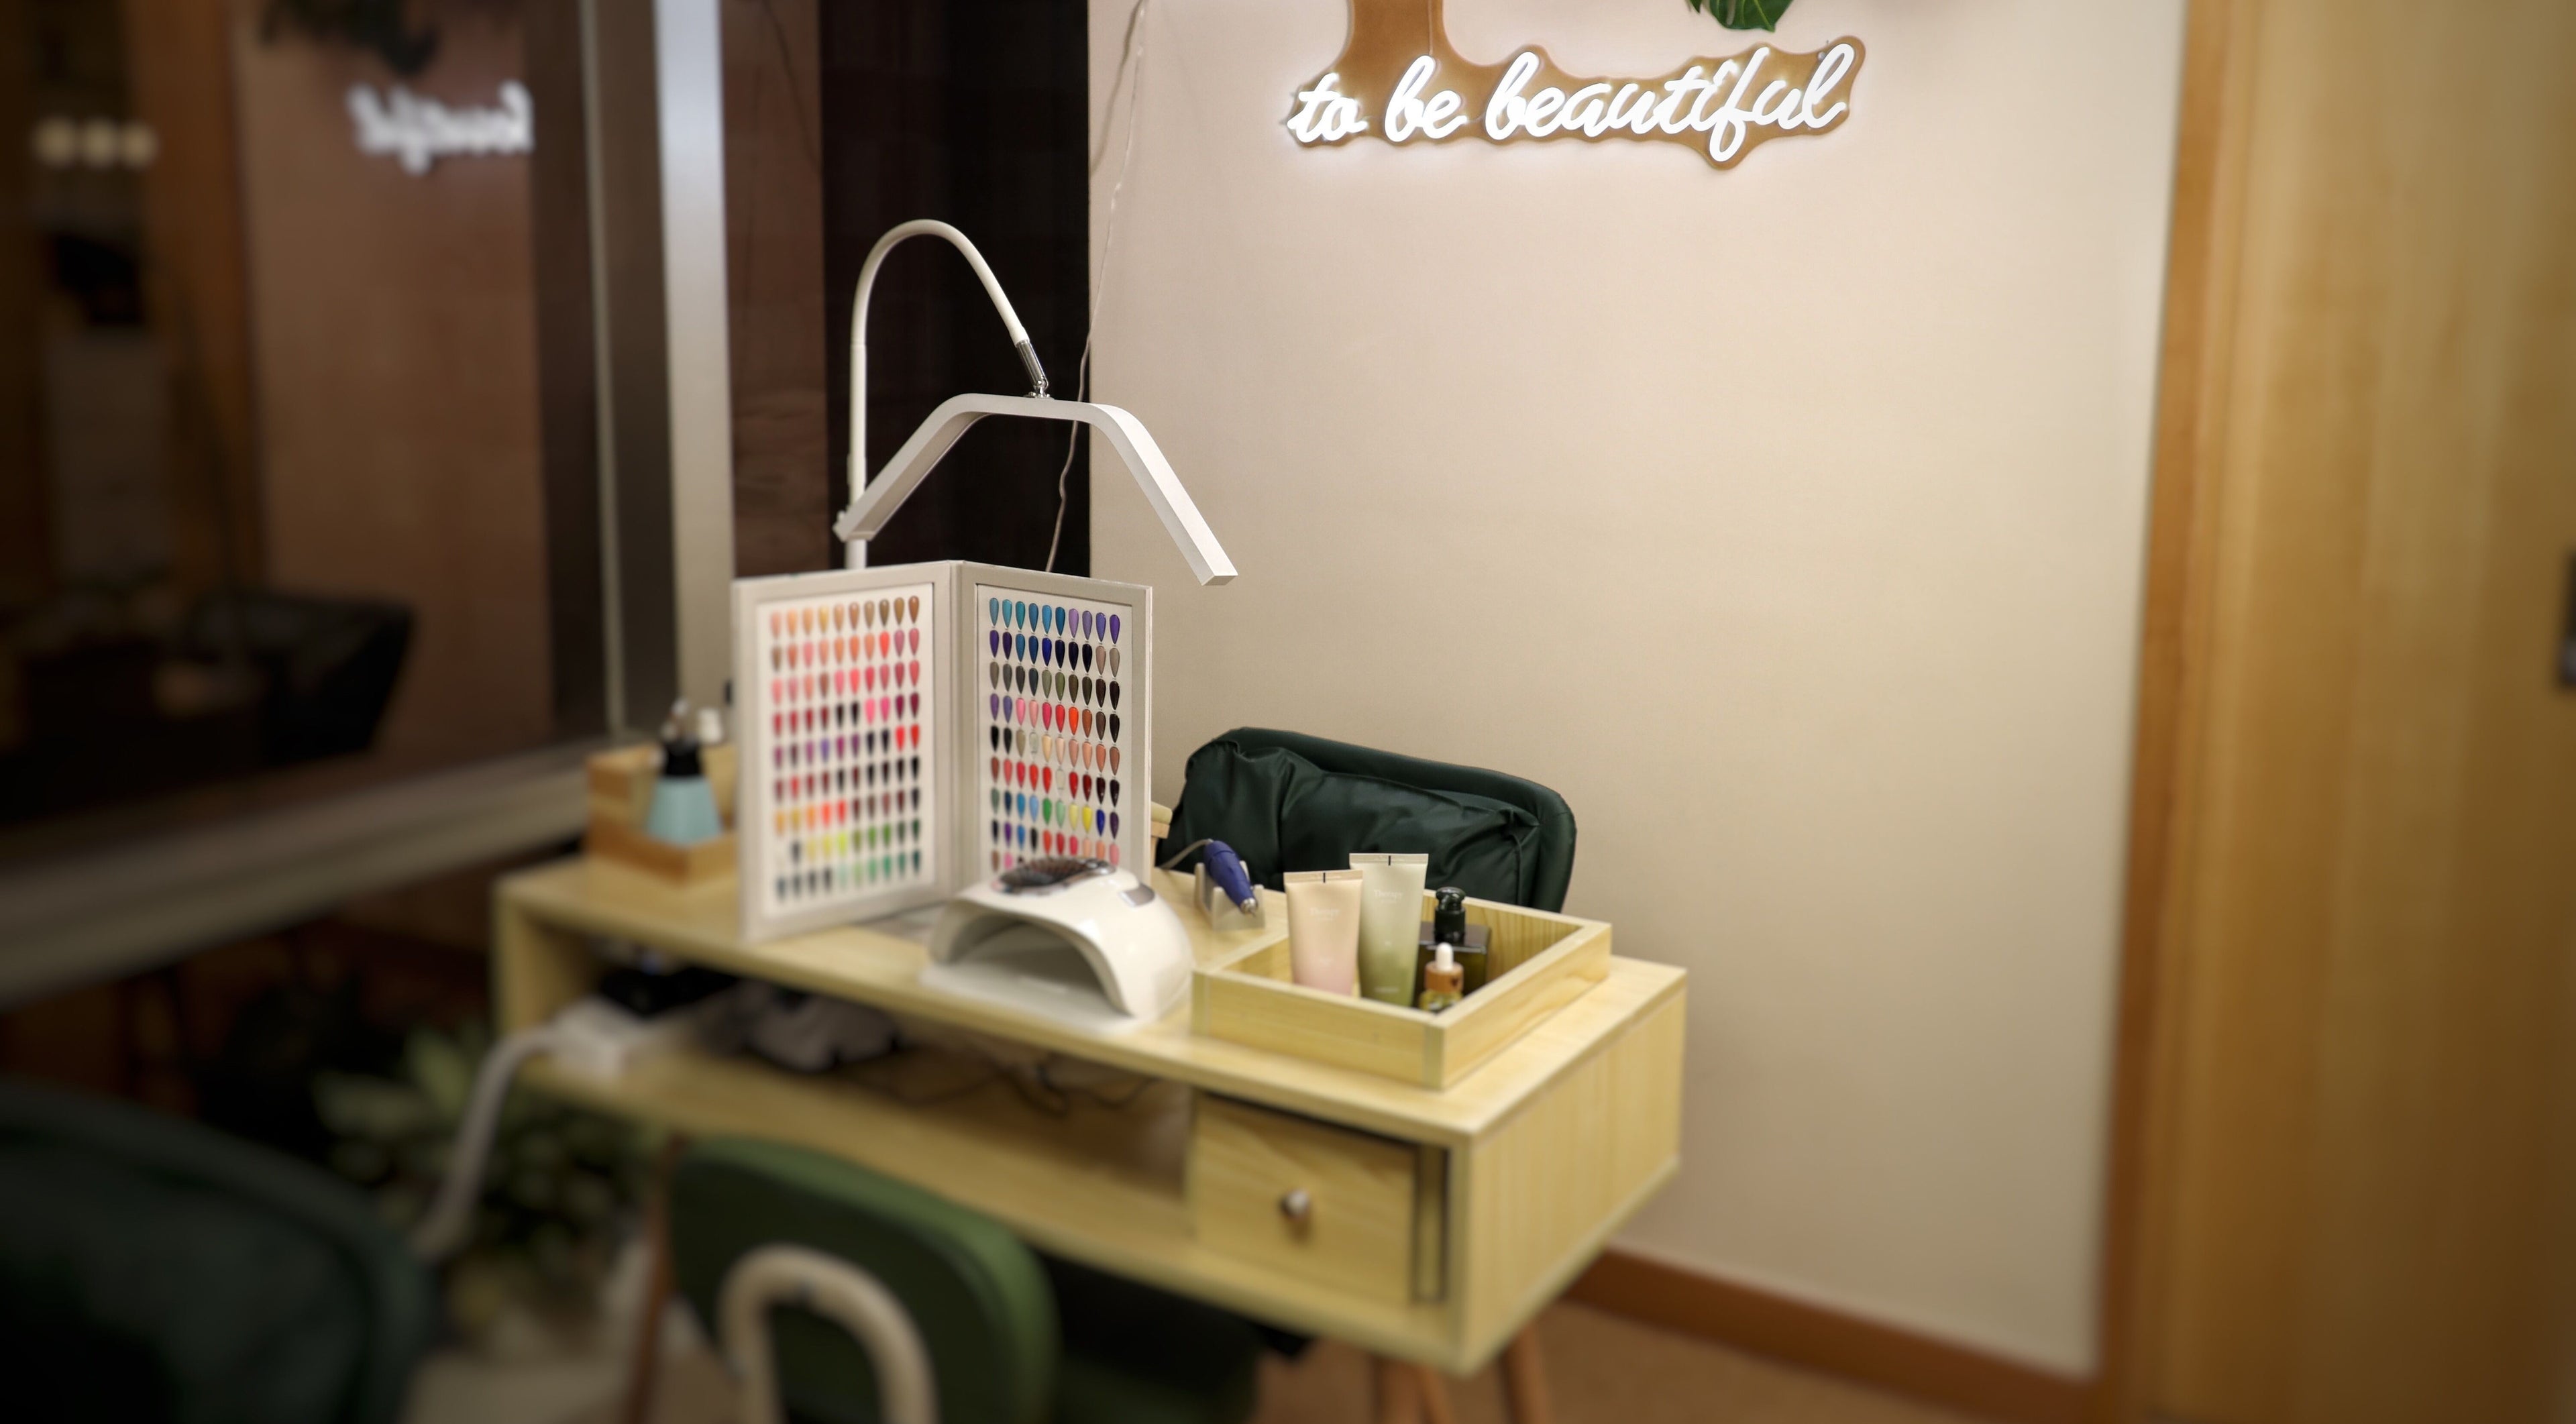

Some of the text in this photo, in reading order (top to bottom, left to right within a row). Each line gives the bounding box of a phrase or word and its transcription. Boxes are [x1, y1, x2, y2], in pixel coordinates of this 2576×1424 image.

[1287, 44, 1854, 162] to be beautiful
